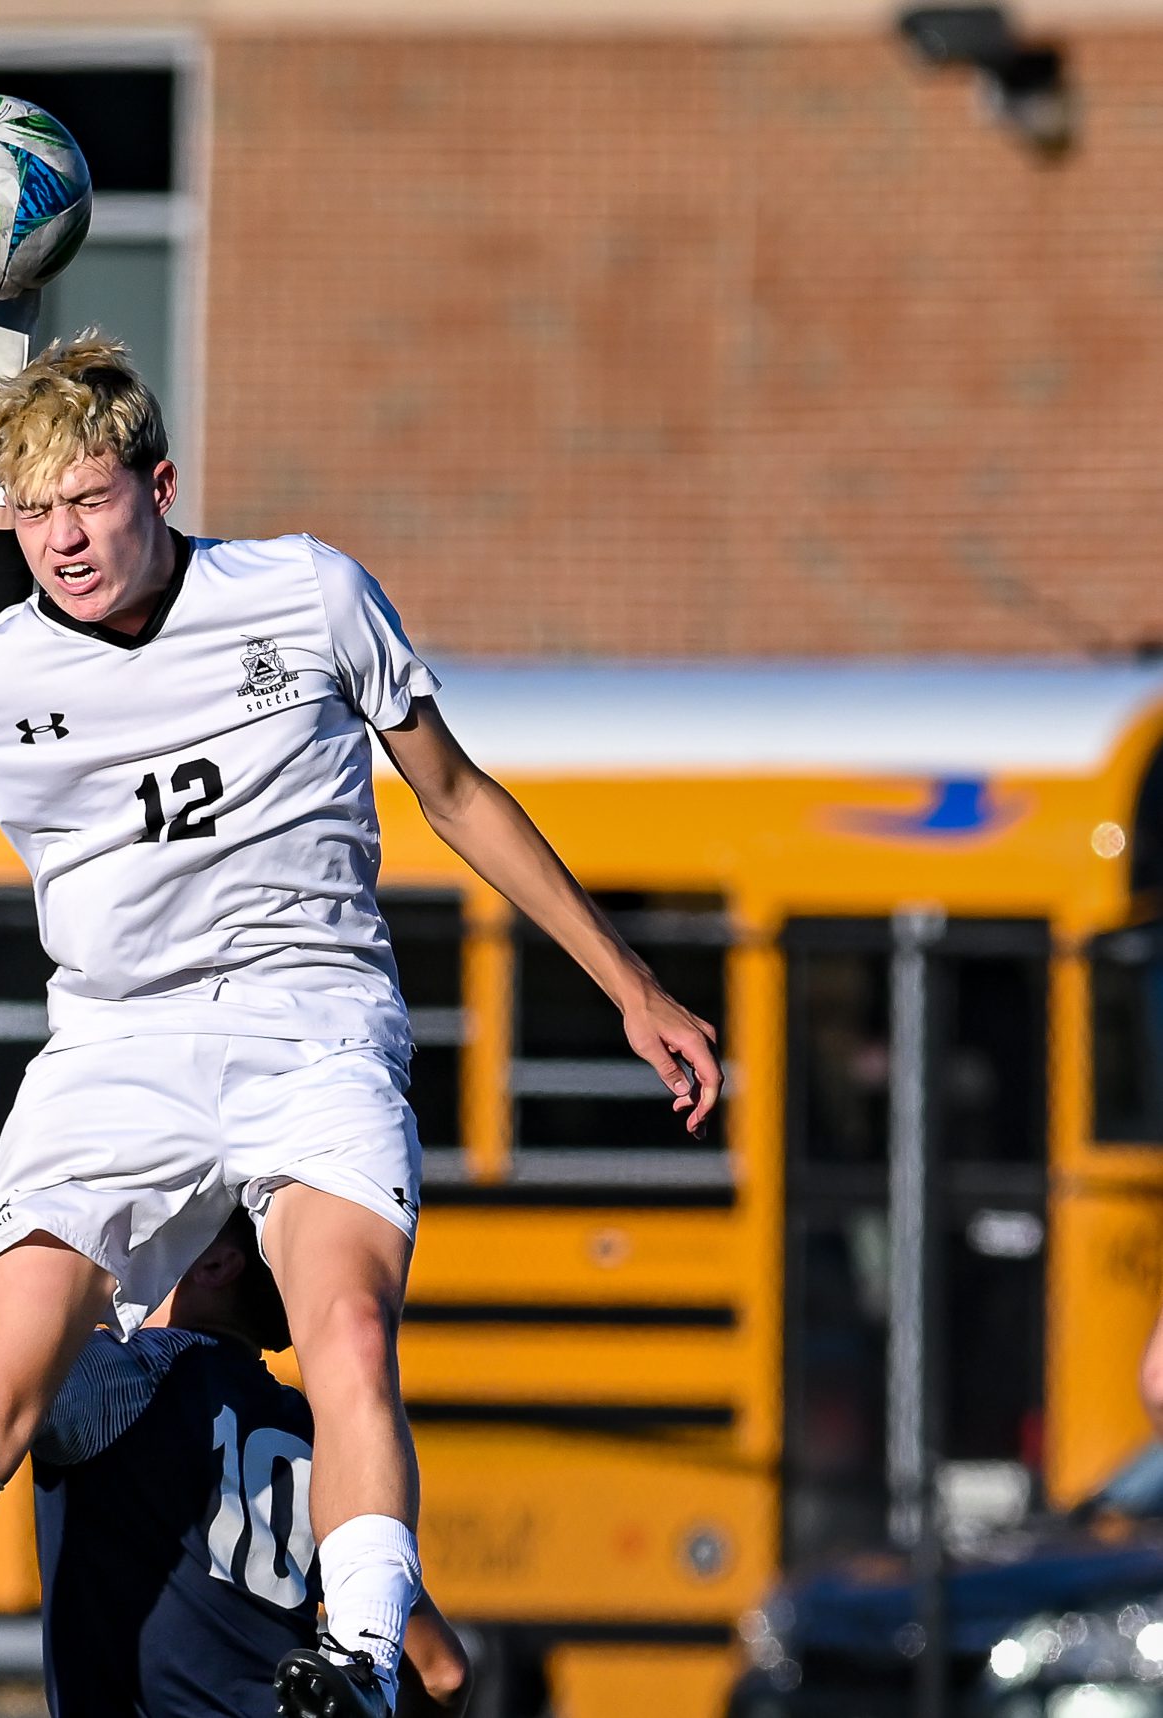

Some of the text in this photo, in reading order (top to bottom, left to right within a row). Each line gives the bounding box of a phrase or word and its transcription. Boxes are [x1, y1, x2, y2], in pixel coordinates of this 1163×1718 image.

[246, 689, 300, 713] SOCCER
[133, 757, 224, 844] 12
[207, 1404, 316, 1609] 10
